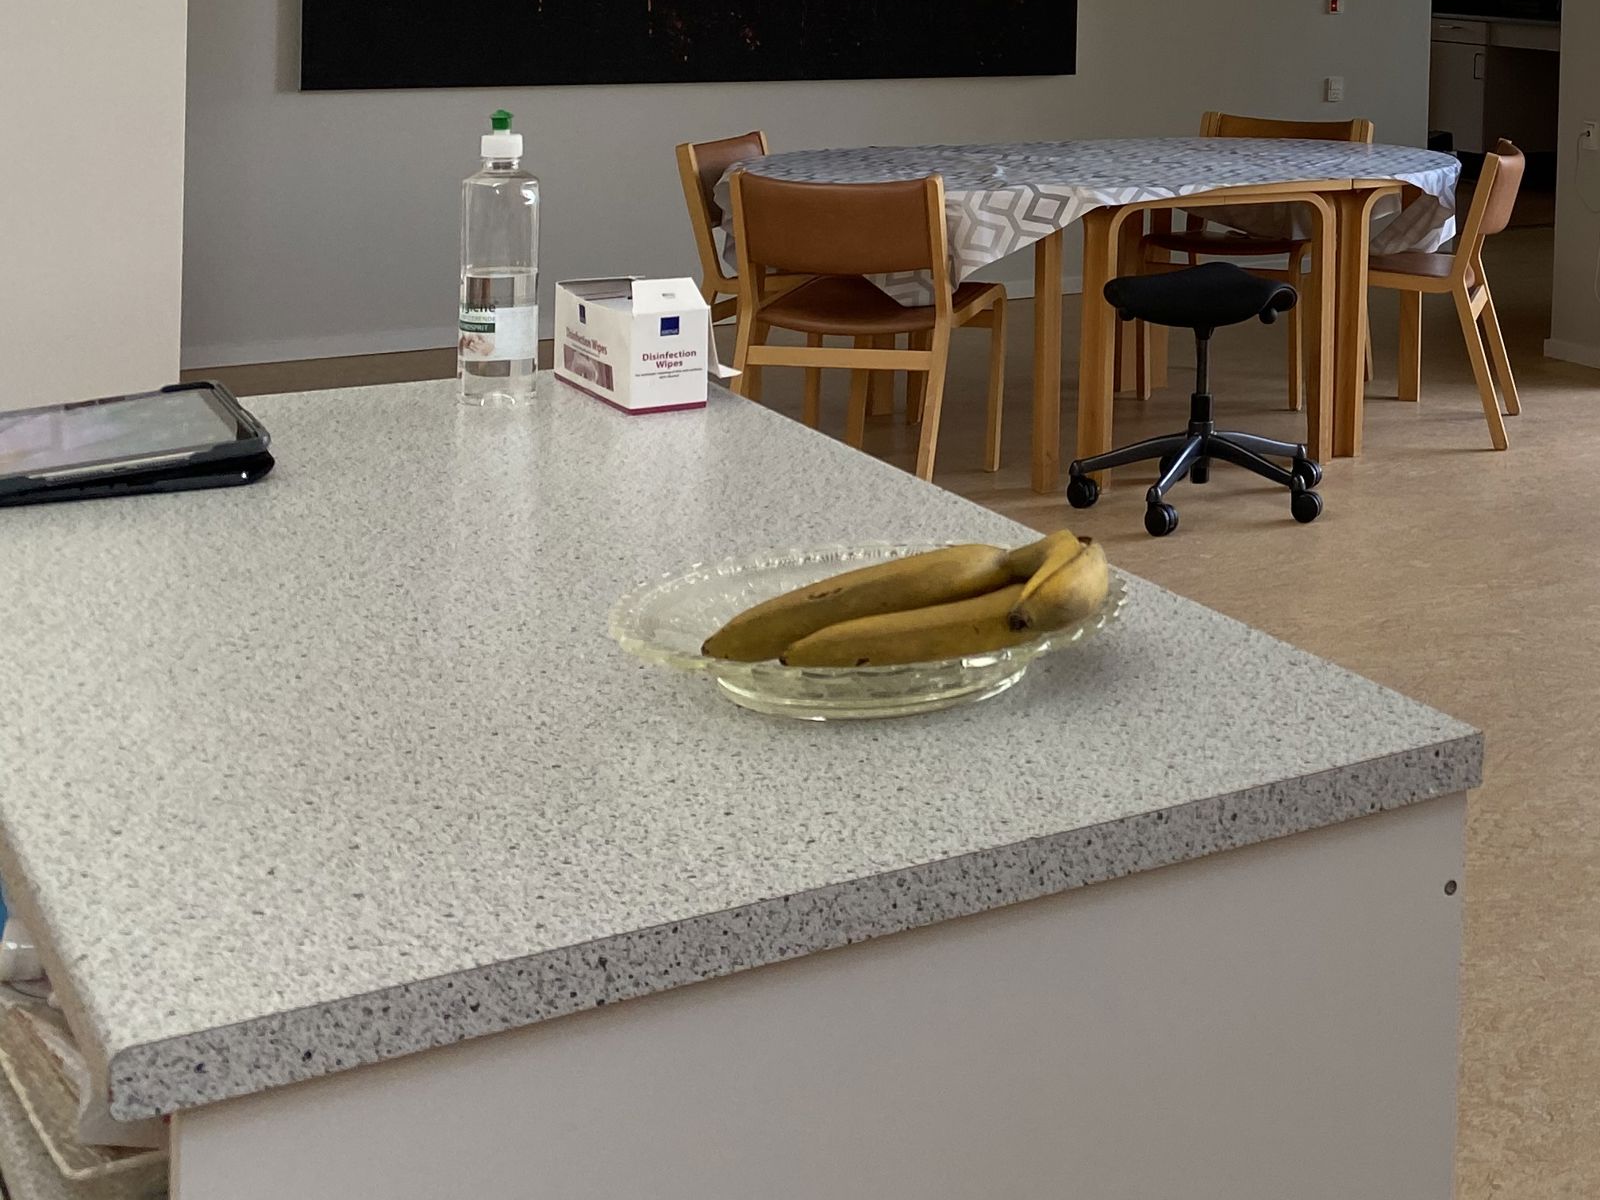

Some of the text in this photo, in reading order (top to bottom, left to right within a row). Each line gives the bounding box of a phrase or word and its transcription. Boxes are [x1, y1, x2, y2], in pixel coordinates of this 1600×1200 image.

[591, 339, 608, 356] Wipes
[642, 350, 697, 362] Disinfection
[656, 360, 683, 369] Wipes
